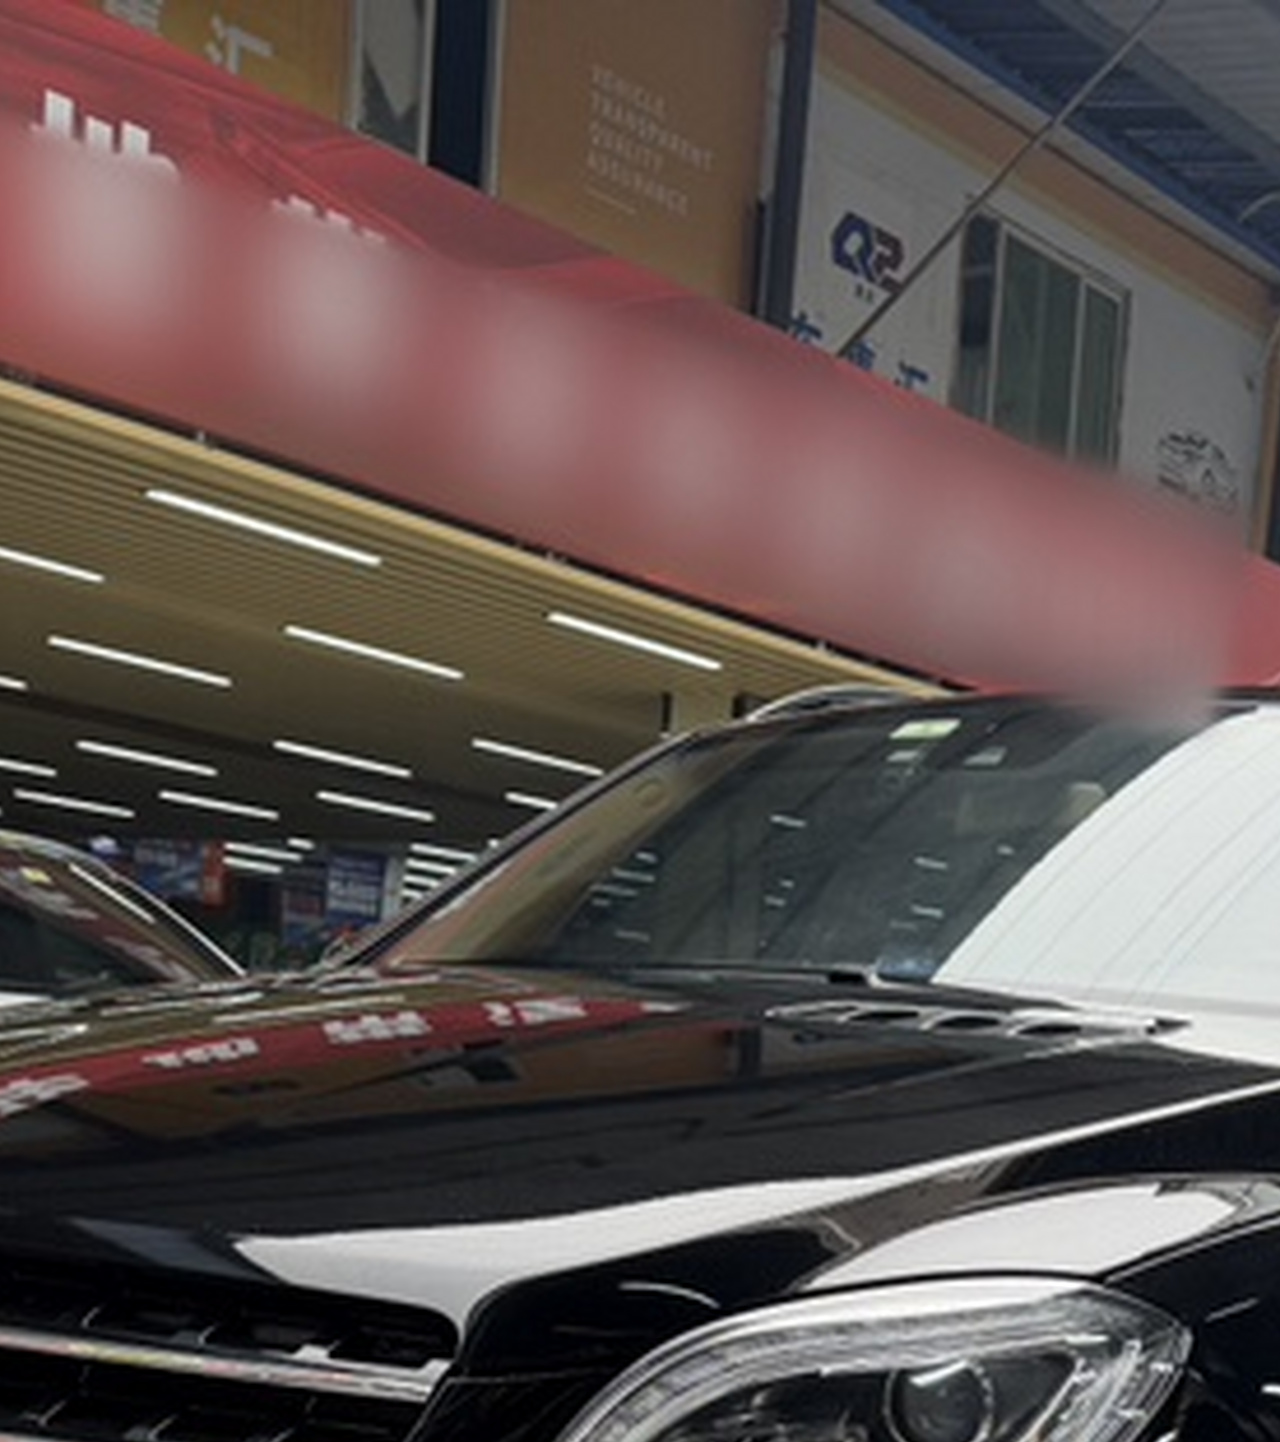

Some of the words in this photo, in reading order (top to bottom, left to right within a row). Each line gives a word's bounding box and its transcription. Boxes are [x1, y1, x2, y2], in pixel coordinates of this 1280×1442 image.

[591, 63, 666, 121] VEHICLE
[588, 119, 664, 174] QUALITY
[590, 88, 713, 173] TRANSPARENT
[585, 149, 689, 217] ASSURANCE
